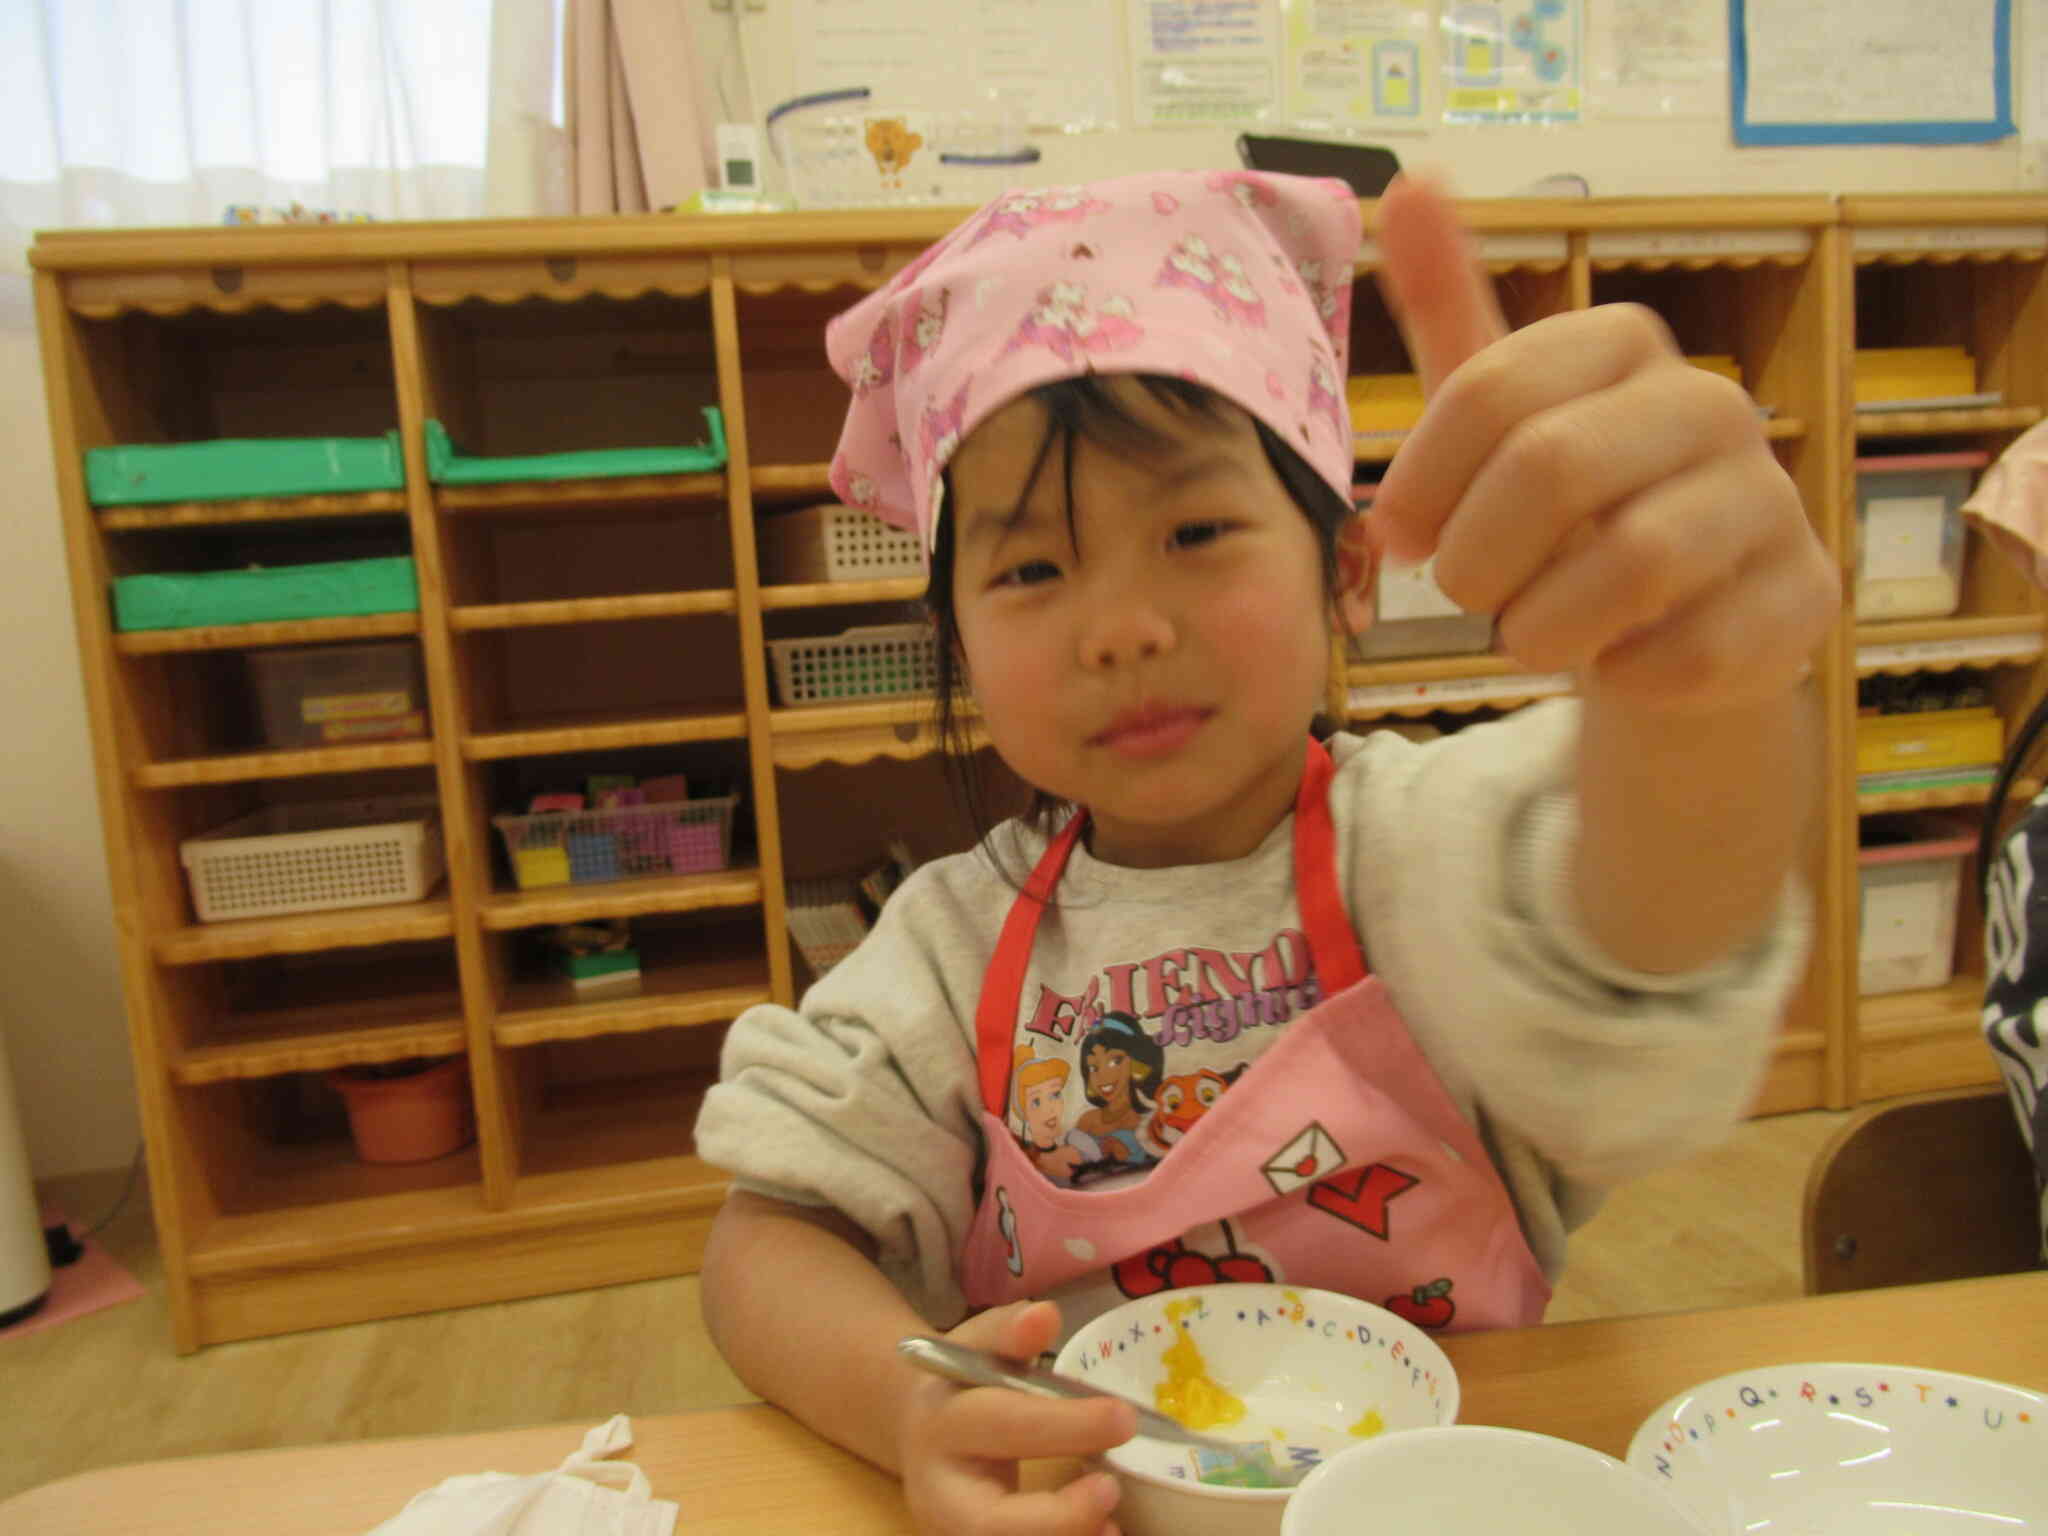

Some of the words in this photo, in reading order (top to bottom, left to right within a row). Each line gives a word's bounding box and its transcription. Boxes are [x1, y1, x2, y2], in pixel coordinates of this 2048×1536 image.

[1739, 1386, 1766, 1408] Q
[1855, 1387, 1874, 1408] S
[1913, 1384, 1934, 1404] T
[1984, 1408, 2003, 1430] U
